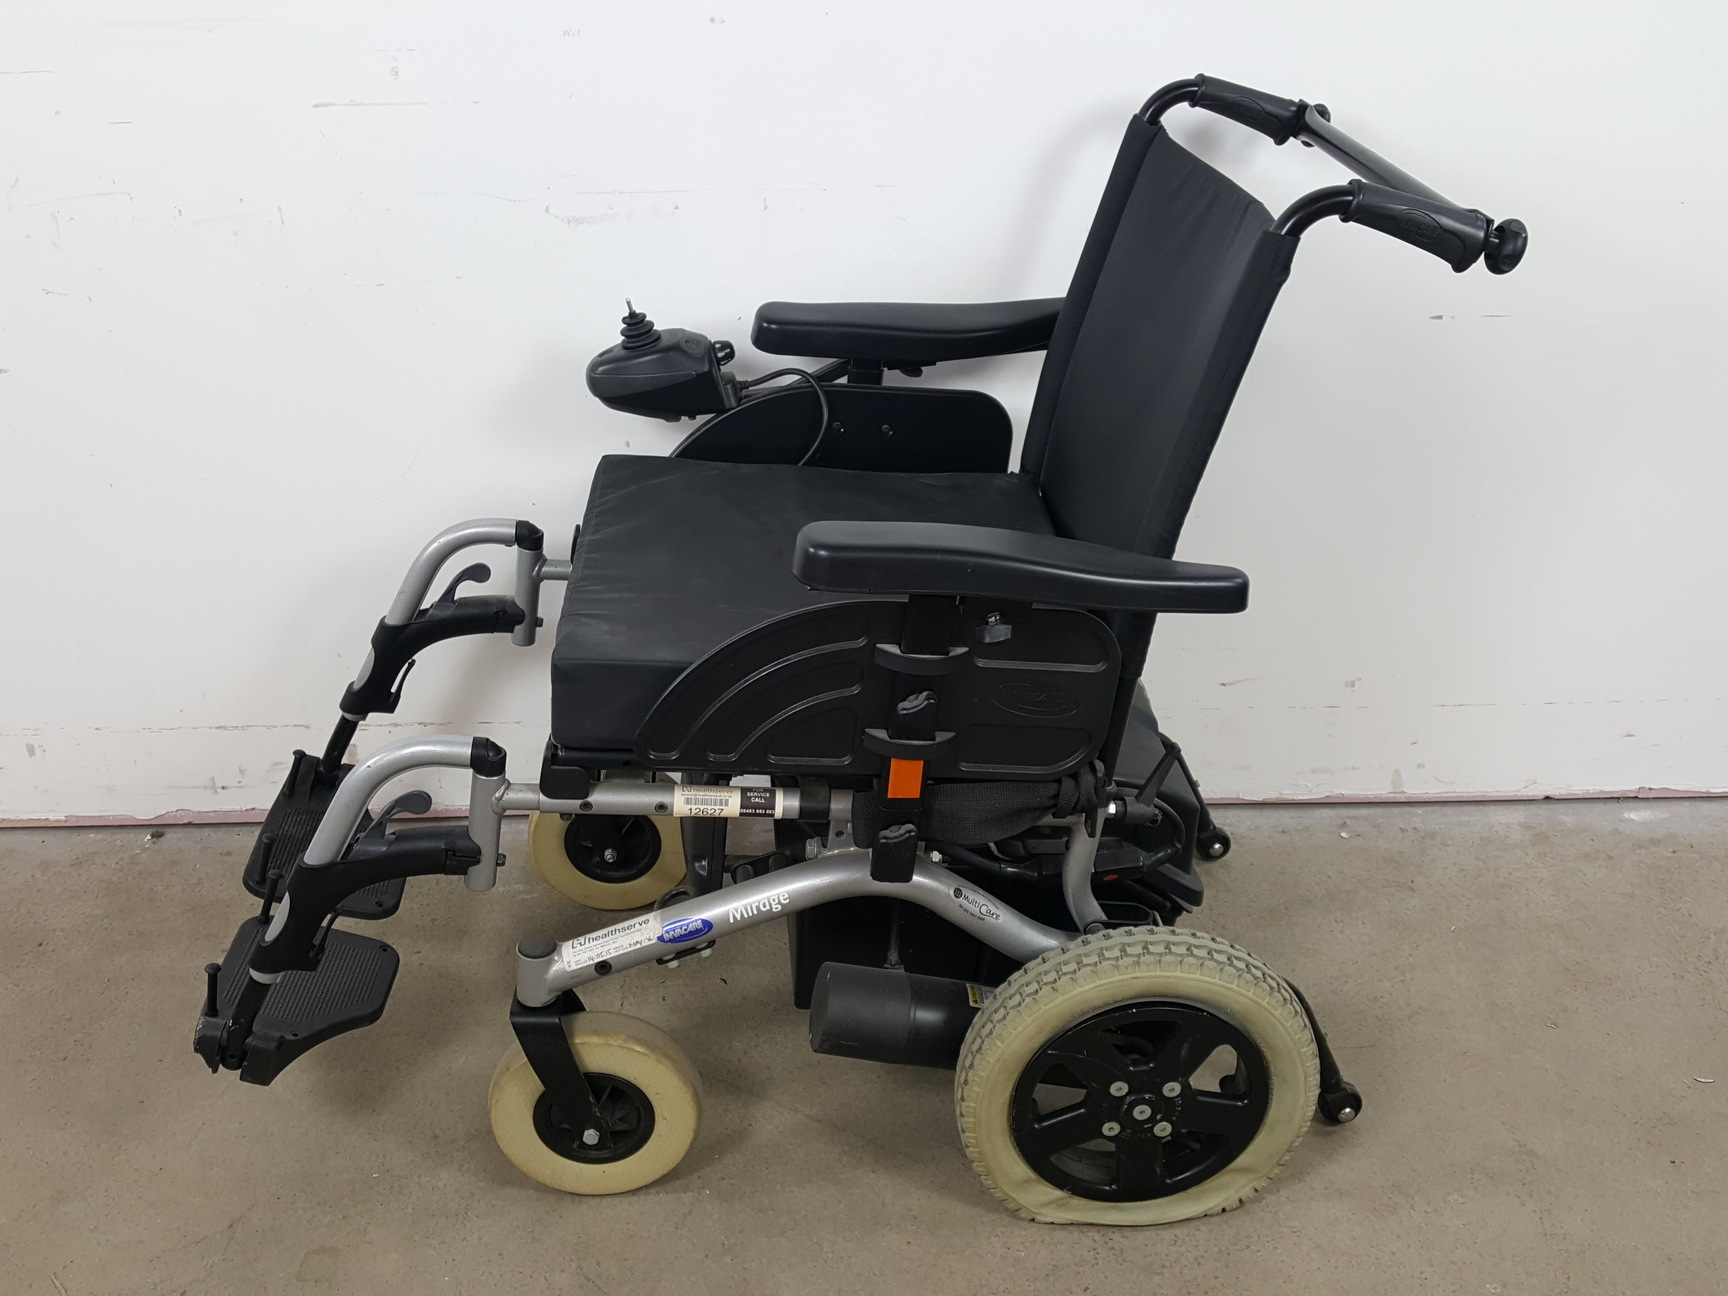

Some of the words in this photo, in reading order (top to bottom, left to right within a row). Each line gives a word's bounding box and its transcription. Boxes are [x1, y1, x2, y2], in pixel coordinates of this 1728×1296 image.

[692, 786, 734, 794] healthserve
[687, 807, 725, 816] 12627
[728, 892, 790, 924] Mirage
[587, 918, 650, 944] healthserve
[663, 919, 704, 942] INVACARE
